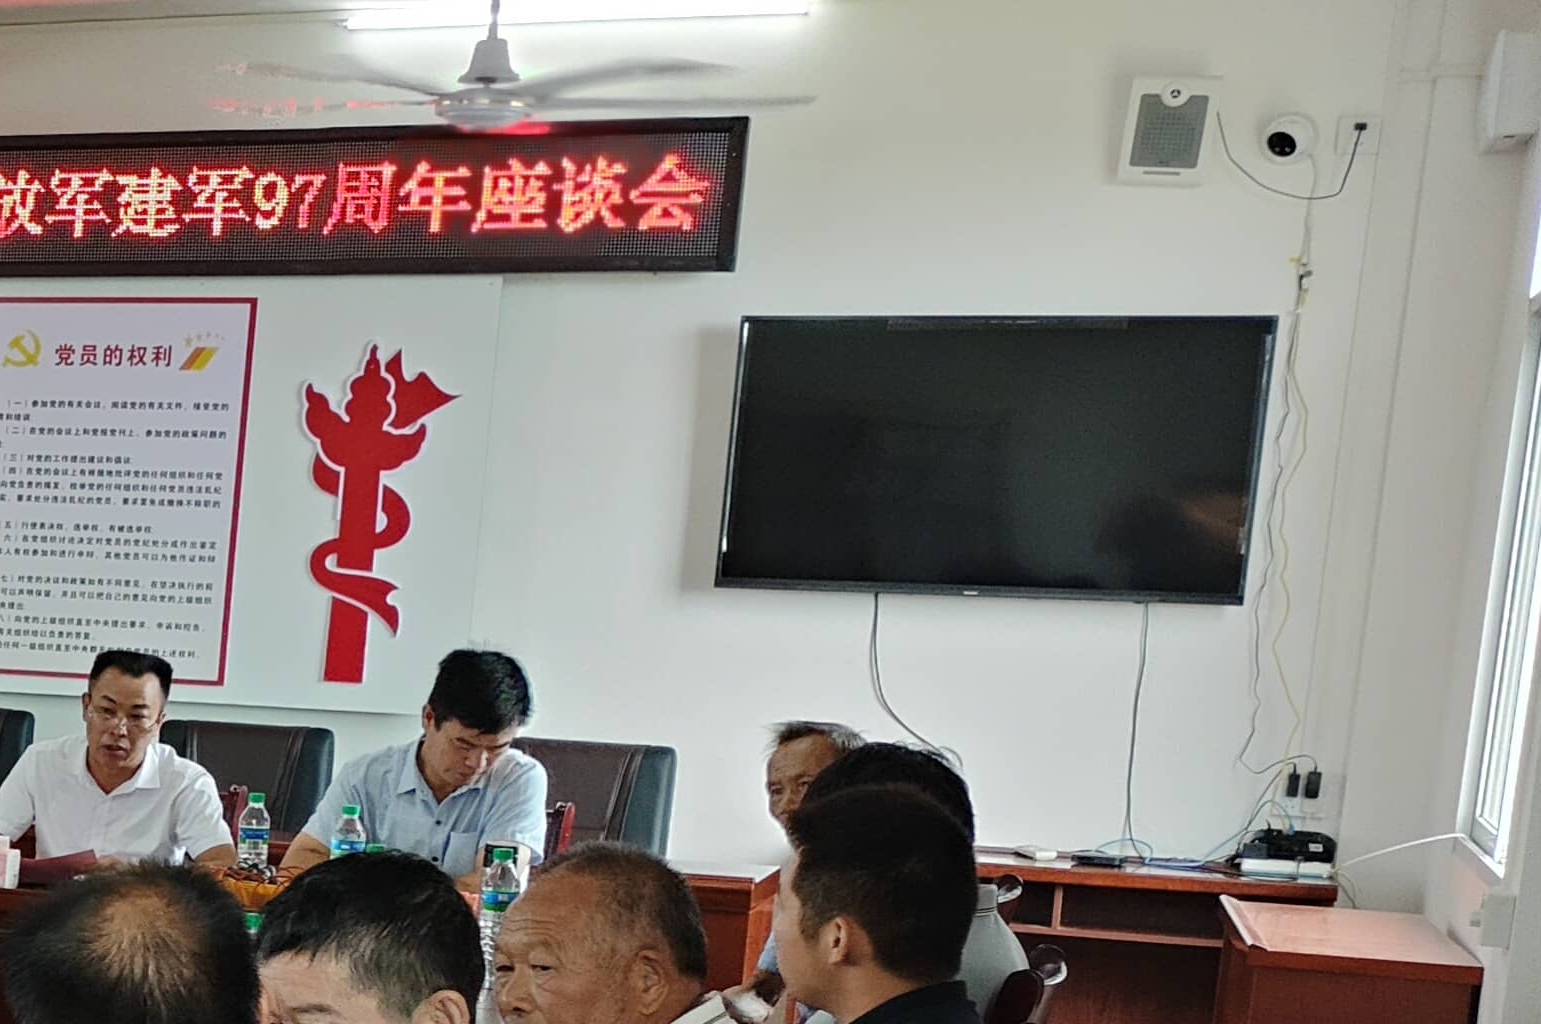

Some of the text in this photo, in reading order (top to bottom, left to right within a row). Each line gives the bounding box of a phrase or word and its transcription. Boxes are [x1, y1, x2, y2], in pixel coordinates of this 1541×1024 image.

[52, 343, 173, 368] 党员的权利
